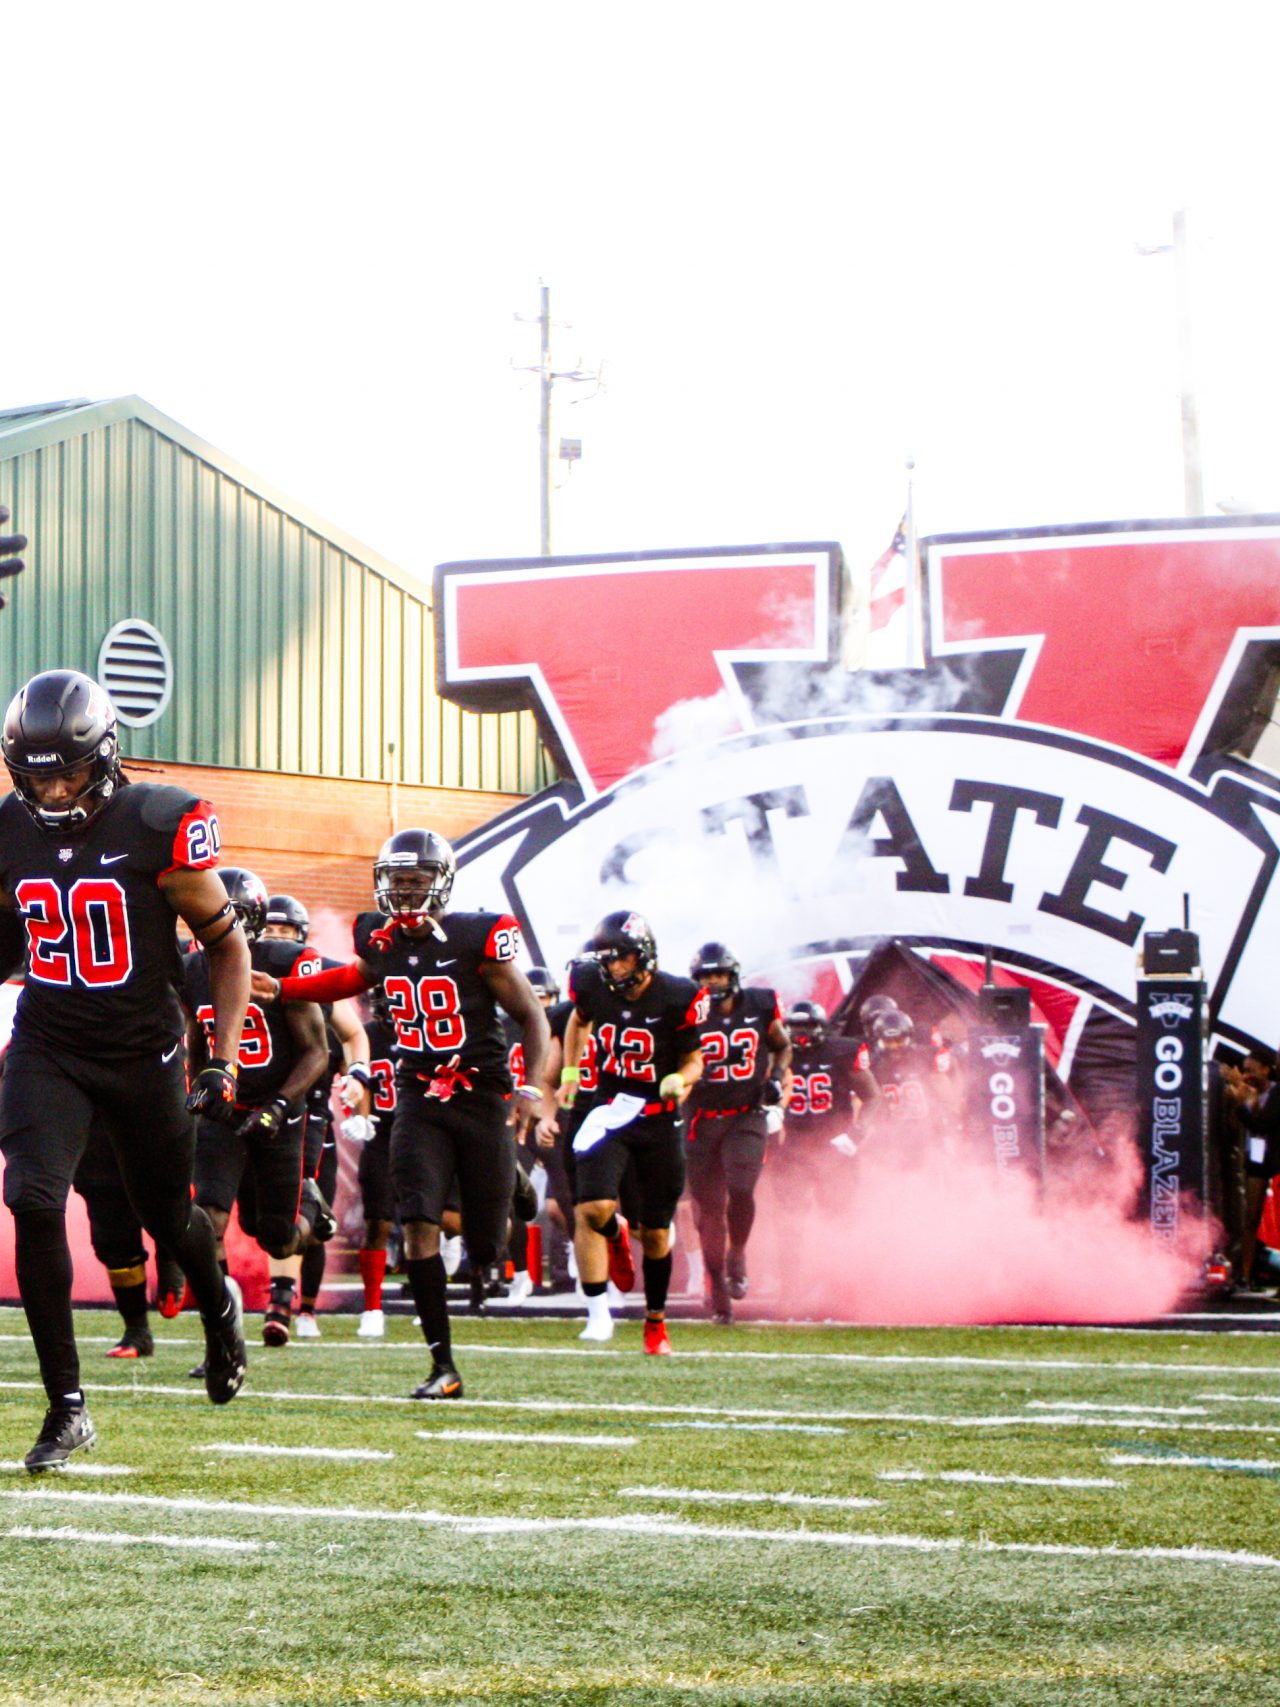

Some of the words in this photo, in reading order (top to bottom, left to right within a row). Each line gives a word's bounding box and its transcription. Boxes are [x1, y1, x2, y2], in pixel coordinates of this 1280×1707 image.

[27, 753, 58, 763] Riddell
[187, 815, 221, 865] 20
[15, 878, 133, 988] 20
[196, 1001, 273, 1069] 9
[384, 975, 466, 1052] 28
[597, 1022, 657, 1083] 12
[699, 1027, 760, 1082] 23
[1154, 1035, 1184, 1091] GO
[989, 1071, 1016, 1120] GO
